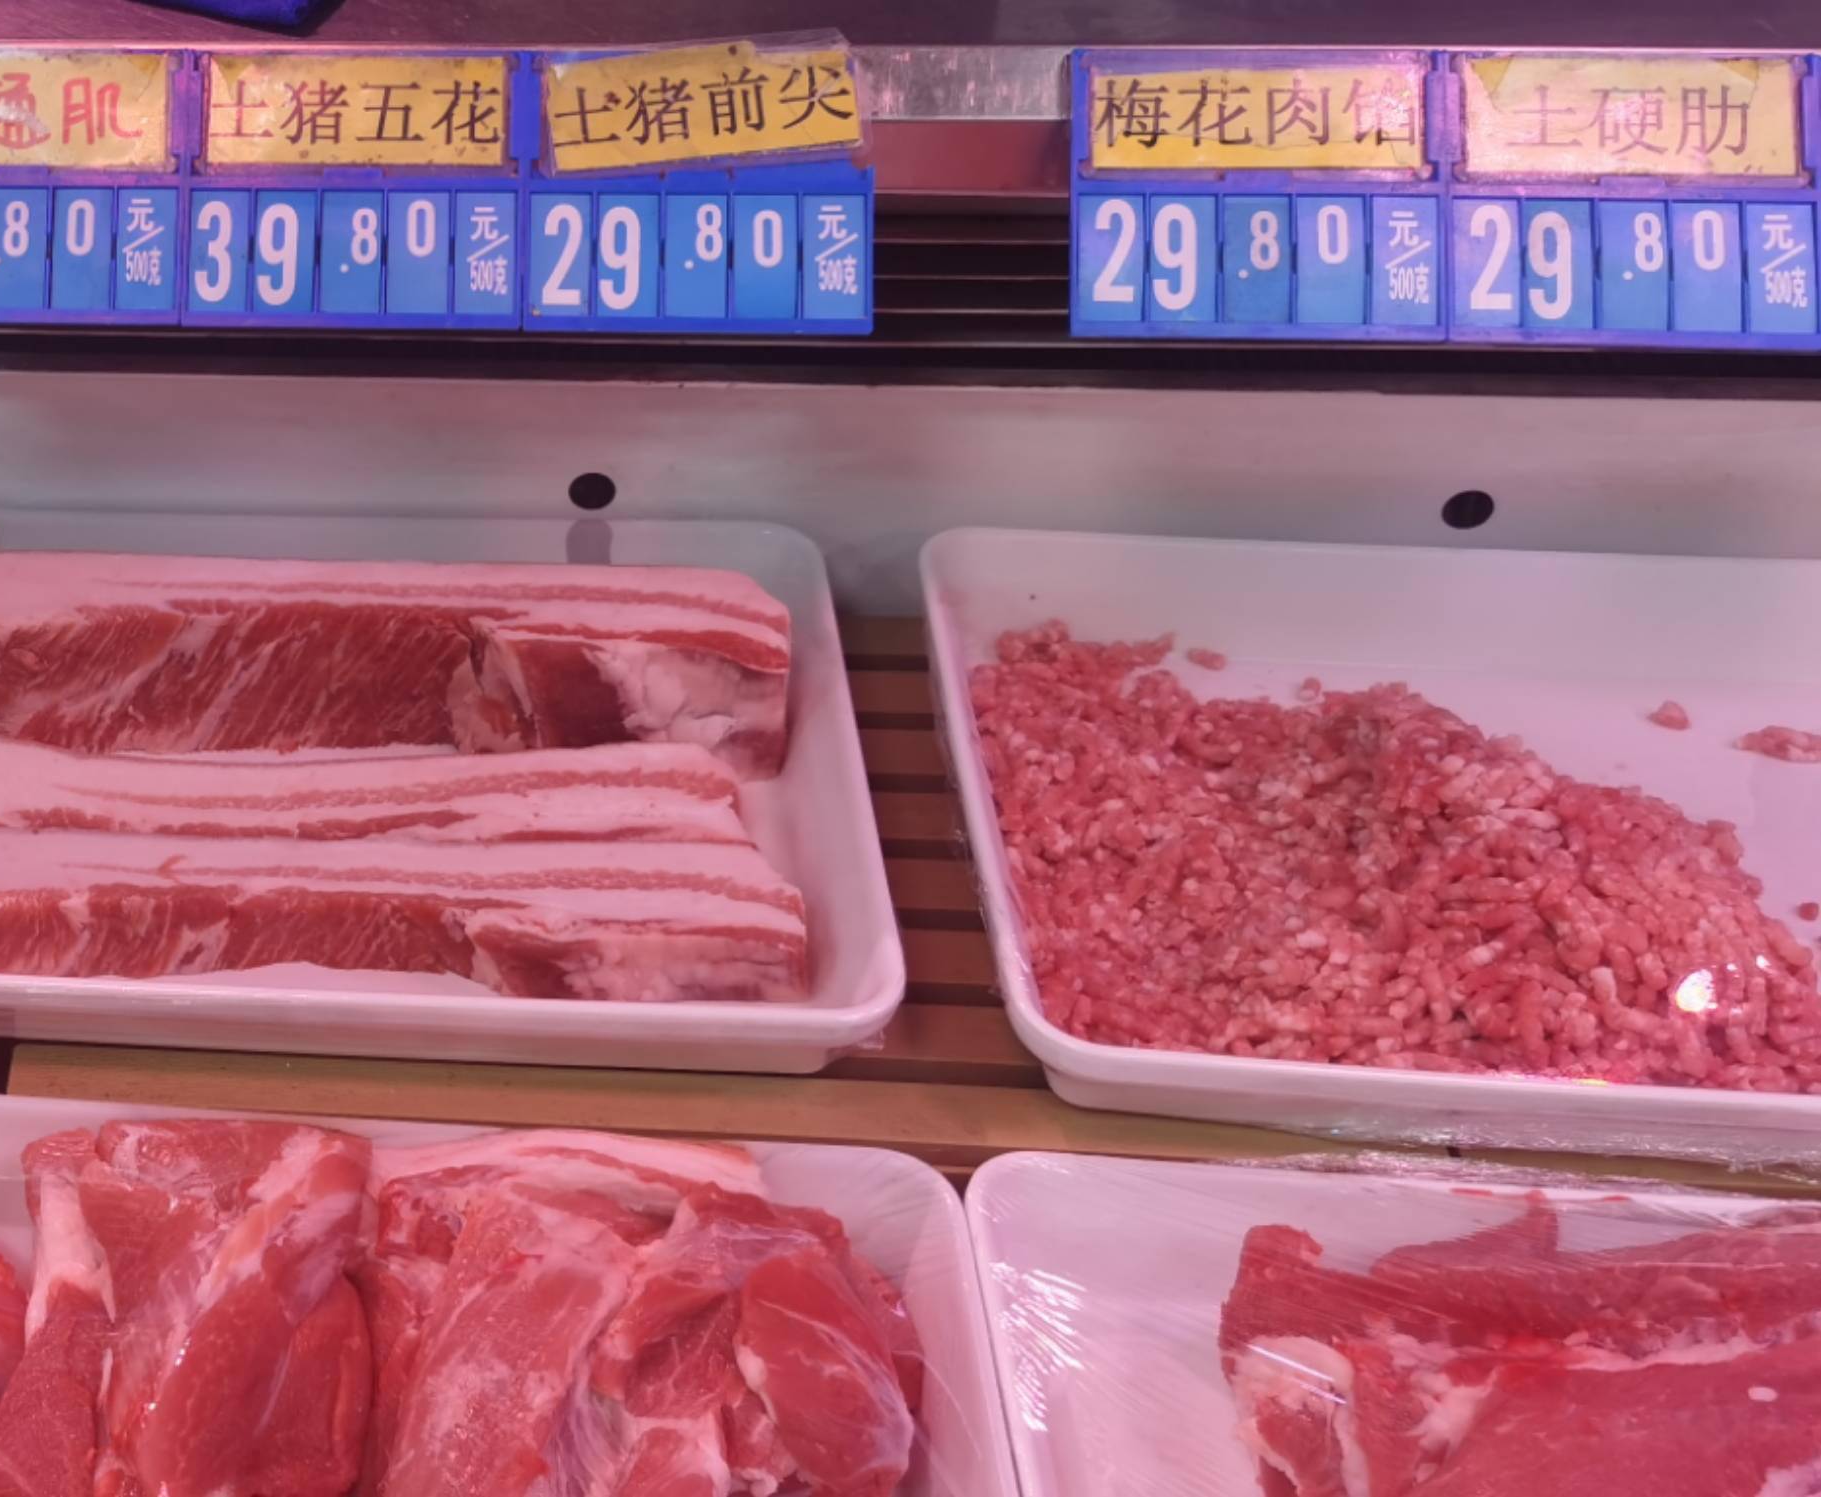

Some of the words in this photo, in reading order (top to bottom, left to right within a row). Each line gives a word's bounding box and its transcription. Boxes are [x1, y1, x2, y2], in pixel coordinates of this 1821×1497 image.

[209, 80, 501, 145] 土猪五花
[554, 65, 854, 147] 土猪前尖
[1507, 84, 1750, 156] 土硬肋
[194, 200, 436, 306] 39.80
[541, 204, 783, 310] 29.80
[1093, 199, 1350, 311] 29.80
[1470, 205, 1725, 319] 29.80
